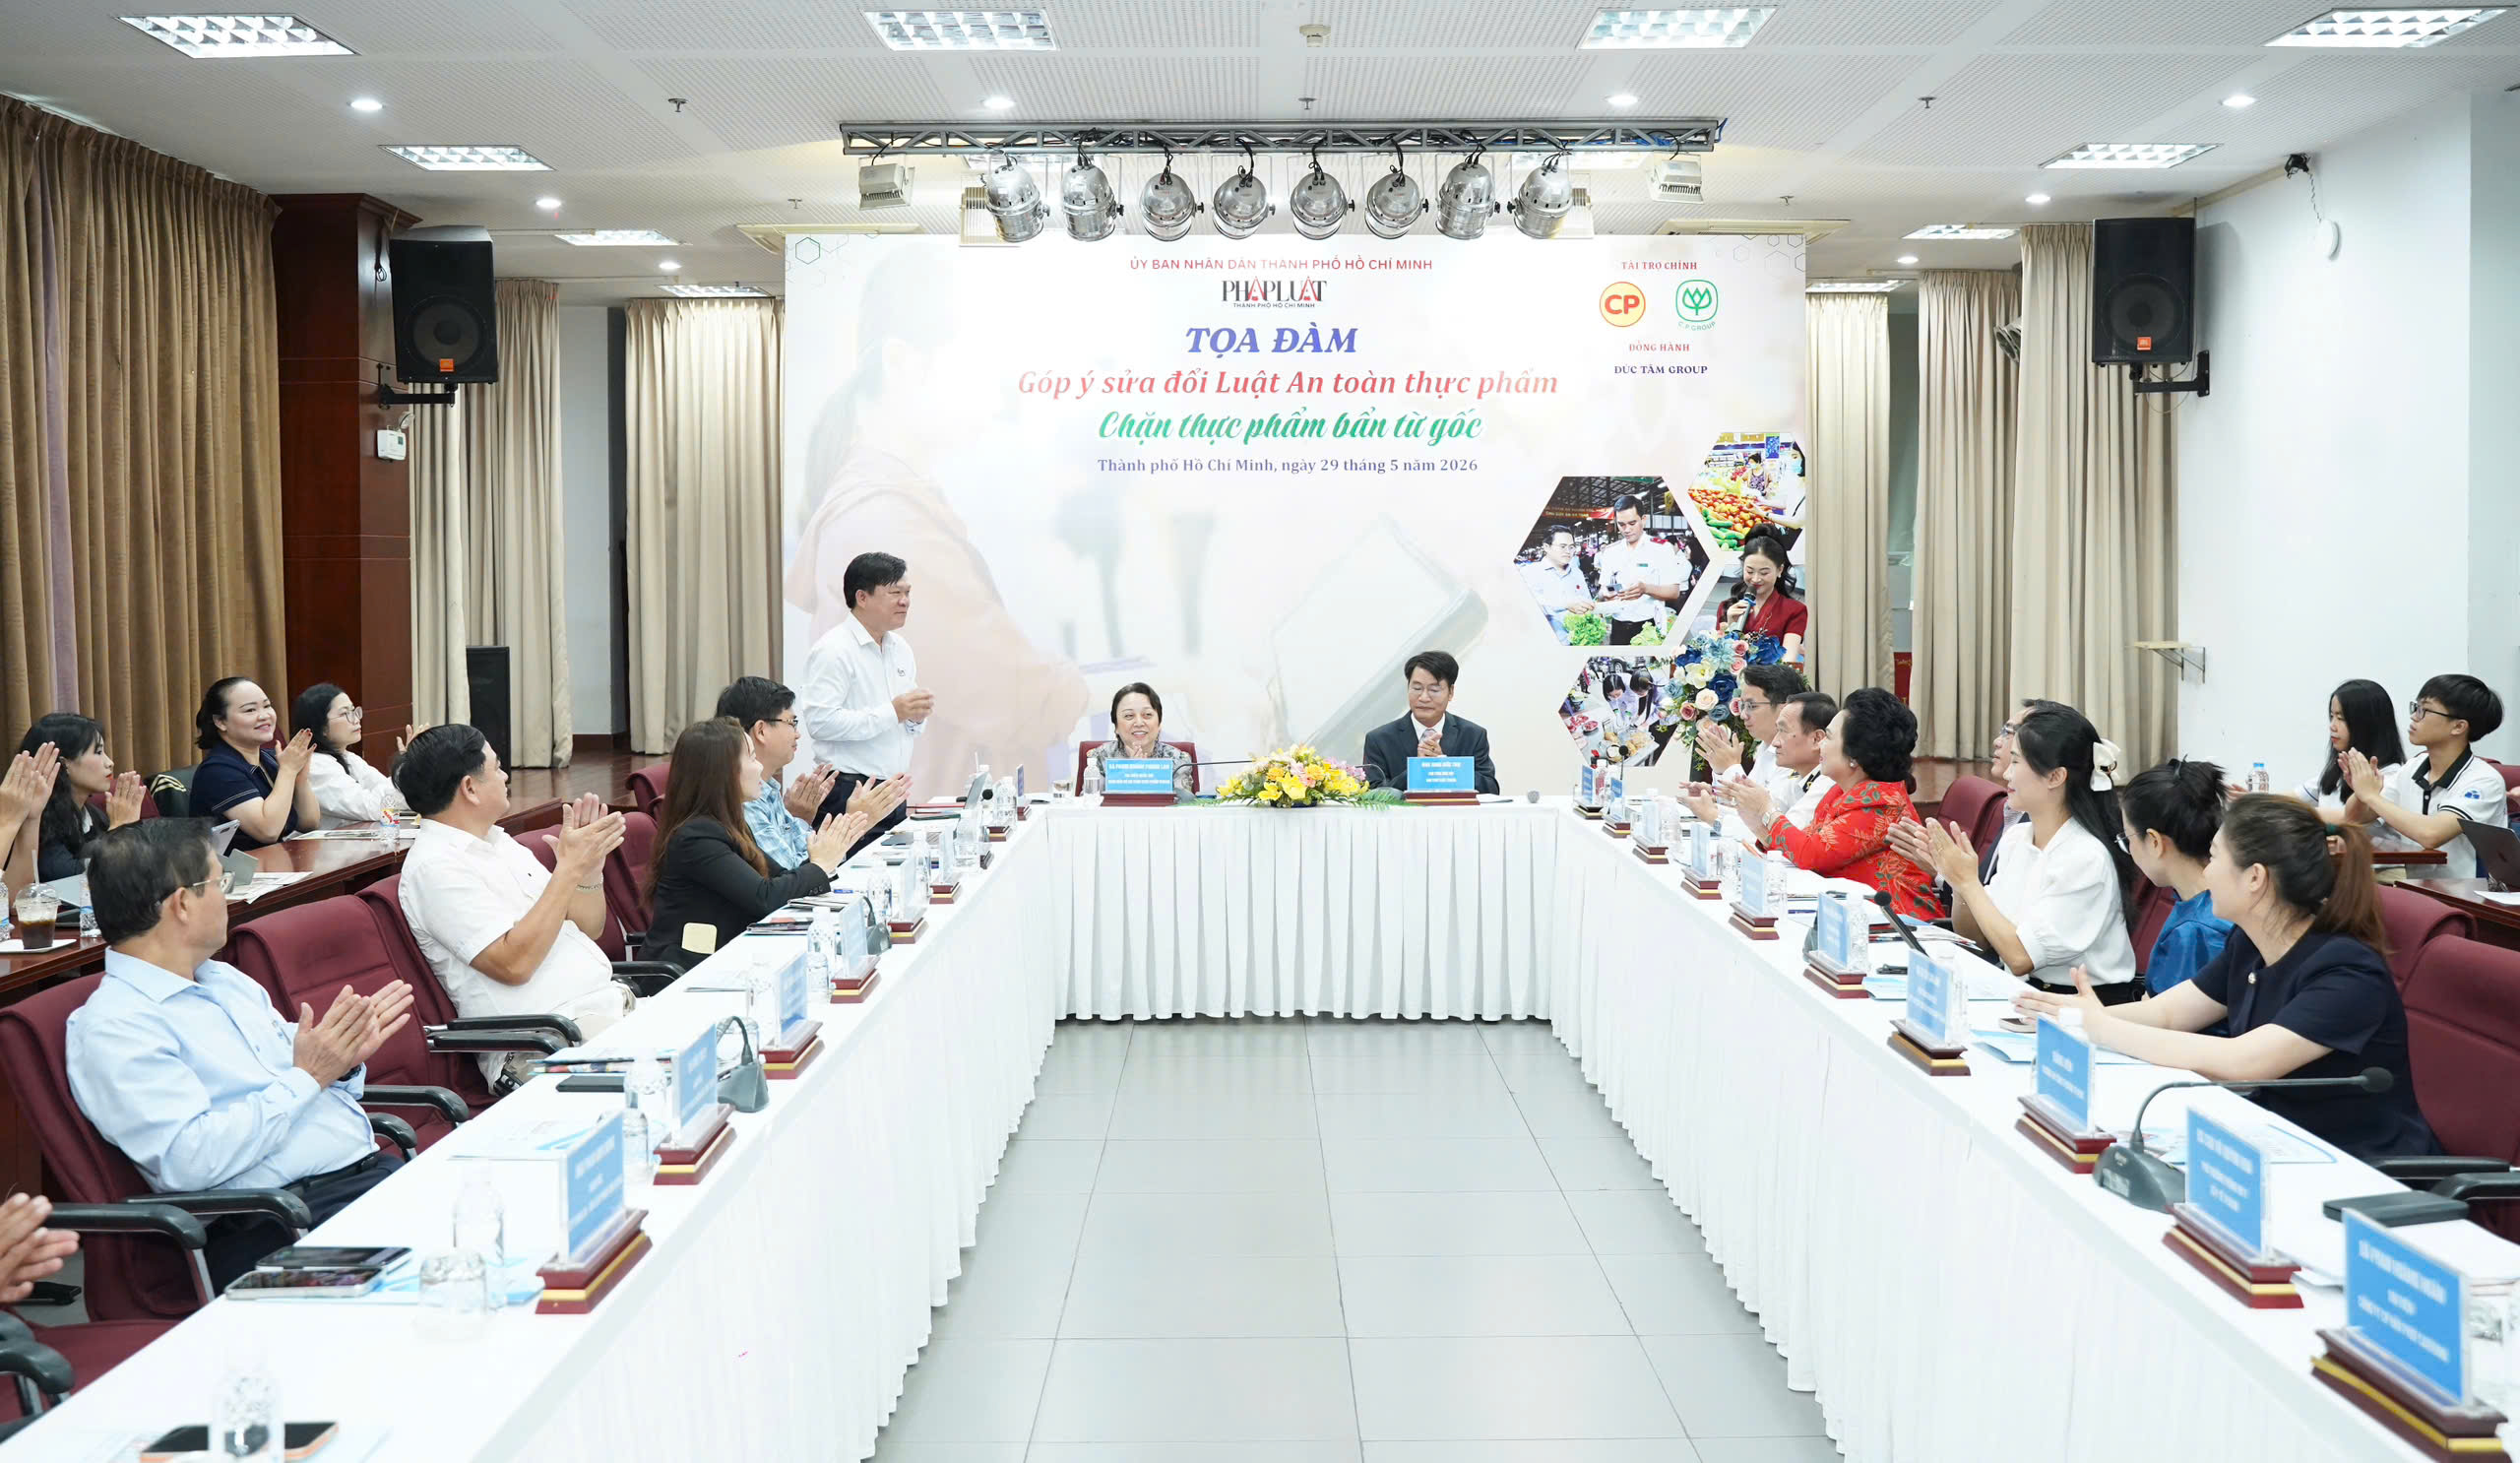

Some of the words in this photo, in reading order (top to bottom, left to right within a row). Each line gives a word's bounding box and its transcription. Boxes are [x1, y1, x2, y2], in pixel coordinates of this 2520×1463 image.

[1152, 260, 1180, 270] BAN
[1396, 260, 1432, 270] MINH
[1605, 294, 1640, 315] CP
[1185, 328, 1260, 358] TỌA
[1271, 322, 1358, 352] ĐÀM
[1669, 365, 1708, 374] GROUP
[1019, 369, 1071, 400] Góp
[1075, 370, 1095, 399] ý
[1102, 368, 1156, 393] sửa
[1164, 367, 1210, 393] đổi
[1216, 370, 1281, 399] Luật
[1286, 371, 1324, 393] An
[1333, 370, 1396, 393] toàn
[1405, 370, 1471, 399] thực
[1099, 411, 1174, 446] Chặn
[1178, 413, 1242, 446] thực
[1242, 407, 1328, 445] phẩm
[1332, 407, 1390, 438] bẩn
[1393, 411, 1427, 438] từ
[1427, 408, 1483, 447] gốc
[1098, 459, 1146, 472] Thành
[1151, 458, 1179, 475] phố
[1183, 459, 1204, 472] Hồ
[1208, 459, 1231, 472] Chí
[1235, 459, 1278, 473] Minh,
[1282, 459, 1316, 475] ngày
[1320, 459, 1339, 472] 29
[1344, 458, 1386, 475] tháng
[1390, 460, 1399, 472] 5
[1403, 459, 1436, 472] năm
[1440, 459, 1478, 472] 2026
